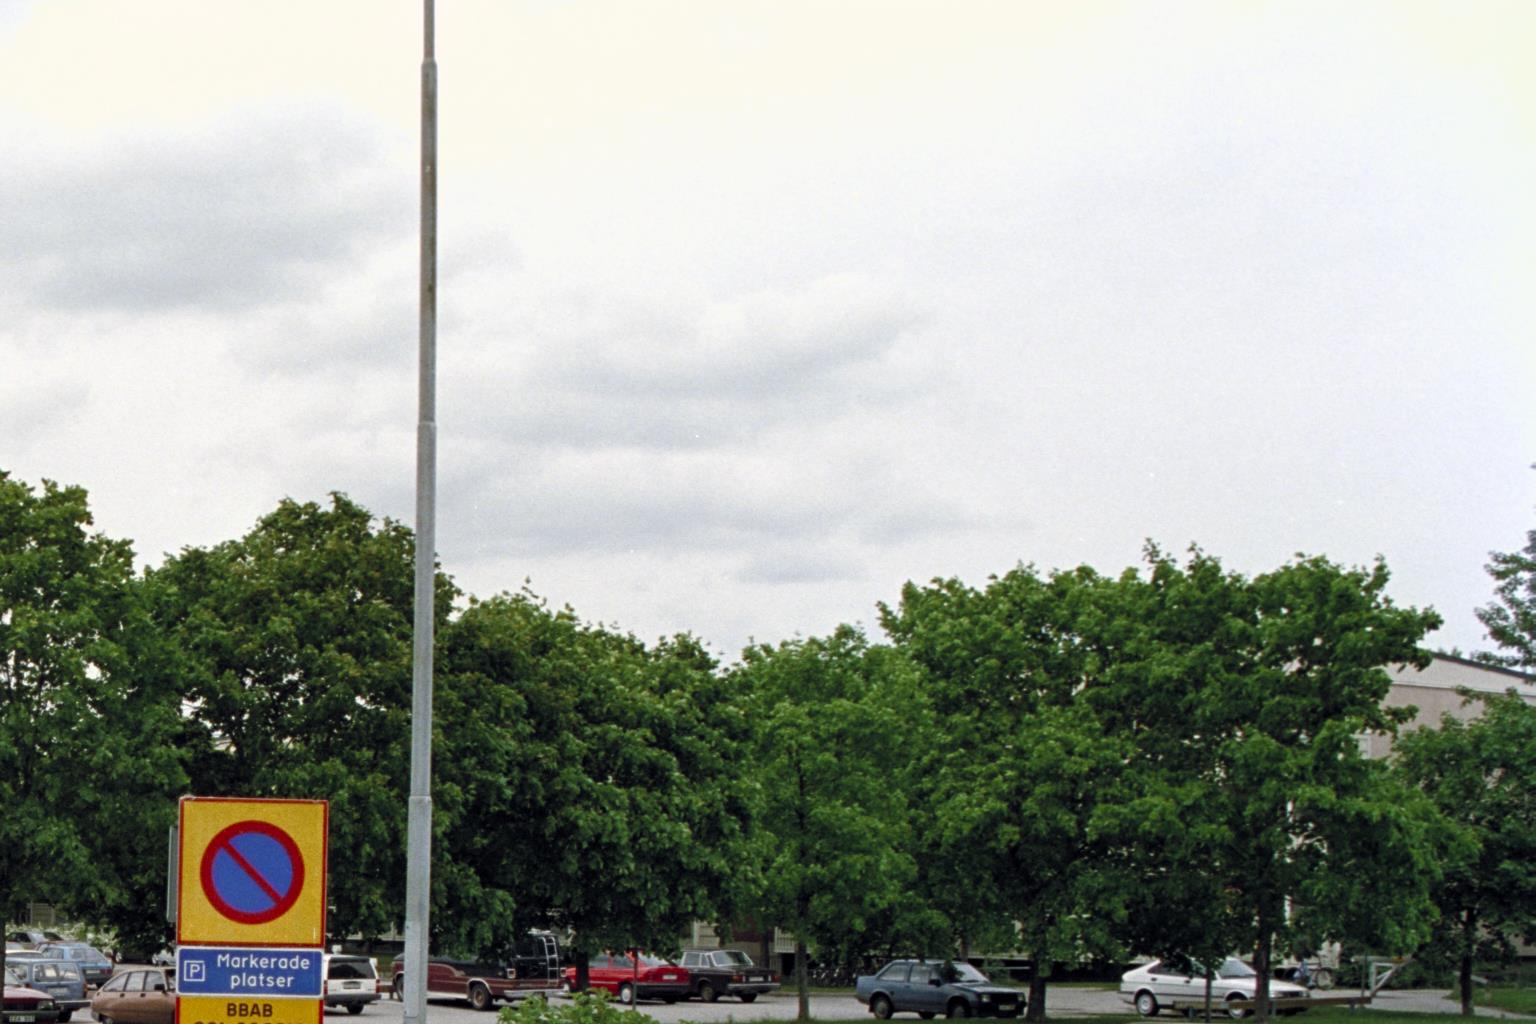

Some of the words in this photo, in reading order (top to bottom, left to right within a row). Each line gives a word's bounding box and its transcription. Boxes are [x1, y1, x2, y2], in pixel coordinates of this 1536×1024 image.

[217, 953, 311, 970] Markerade
[189, 964, 201, 978] P
[230, 973, 295, 990] platser
[226, 1003, 273, 1018] BBAB
